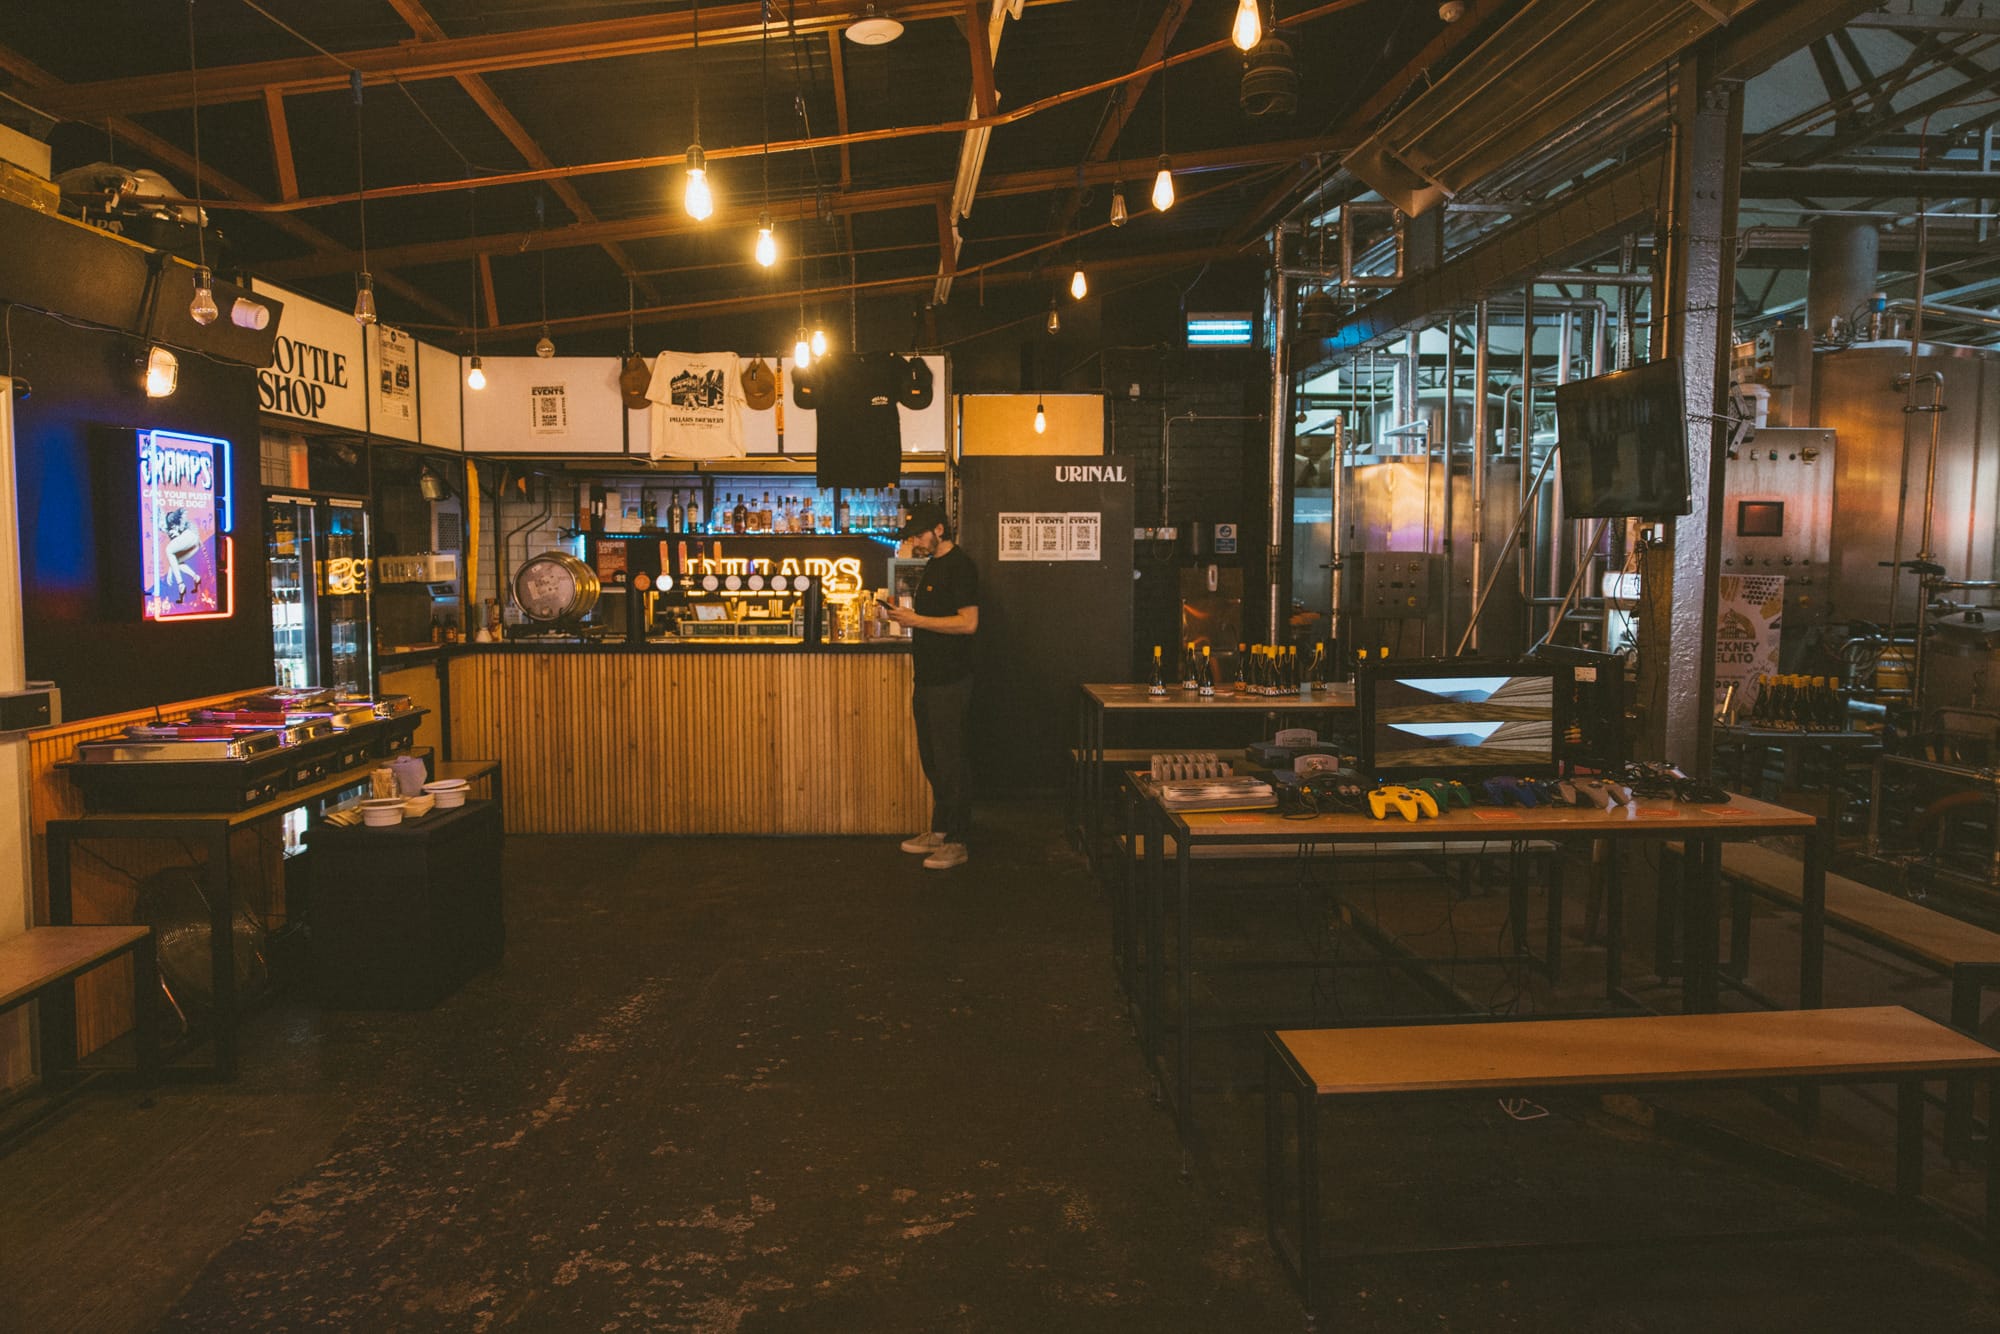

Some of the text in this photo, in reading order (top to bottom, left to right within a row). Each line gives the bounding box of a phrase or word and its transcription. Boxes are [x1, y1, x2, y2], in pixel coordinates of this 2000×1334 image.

[274, 335, 348, 389] OTTLE
[258, 370, 326, 418] SHOP
[1055, 465, 1127, 482] URINAL
[1716, 653, 1754, 663] ELATO
